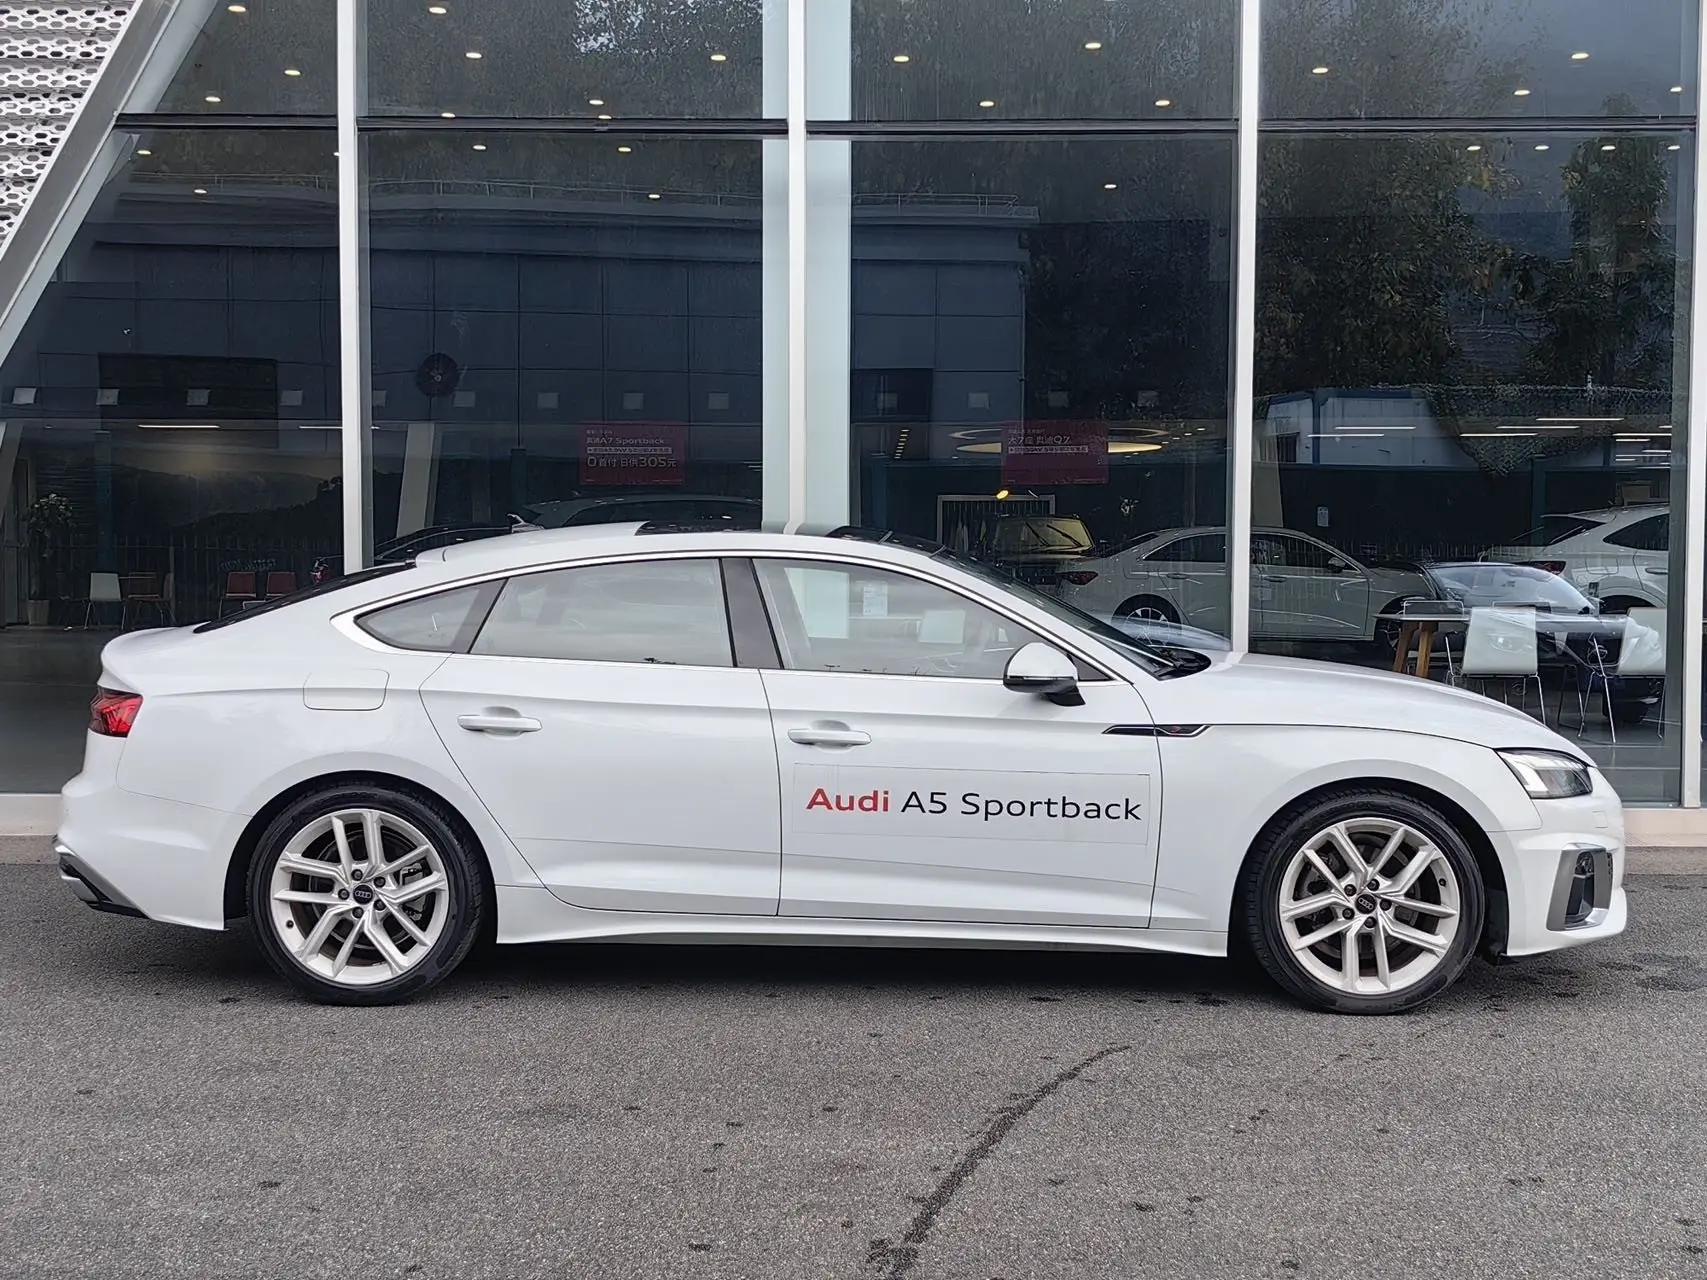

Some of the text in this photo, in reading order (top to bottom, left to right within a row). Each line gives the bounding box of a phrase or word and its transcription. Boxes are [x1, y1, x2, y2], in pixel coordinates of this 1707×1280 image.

[615, 437, 665, 446] Sportback
[806, 788, 1142, 821] Audi A5 Sportback
